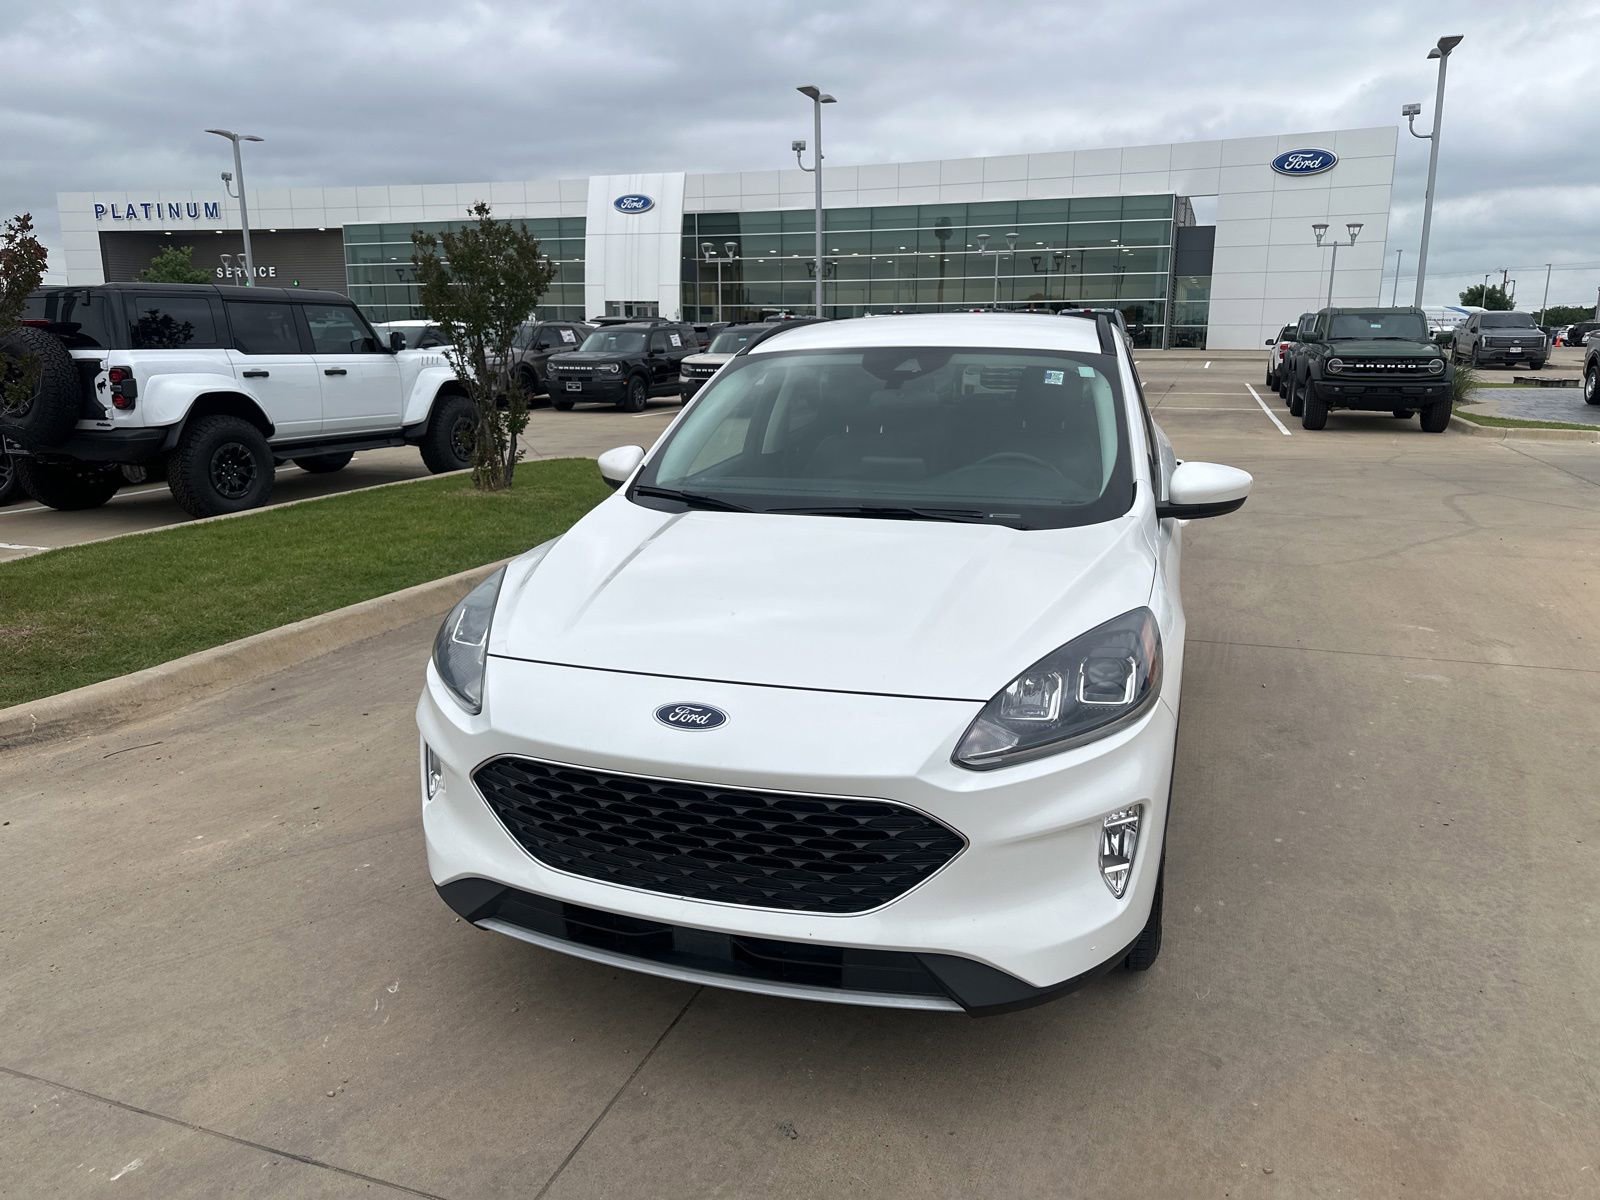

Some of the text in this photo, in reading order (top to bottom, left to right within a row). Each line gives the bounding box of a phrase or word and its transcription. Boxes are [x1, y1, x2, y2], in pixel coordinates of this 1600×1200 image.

[1284, 153, 1323, 169] Ford
[94, 202, 221, 220] PLATINUM
[620, 197, 645, 209] Ford
[668, 705, 712, 725] Ford
